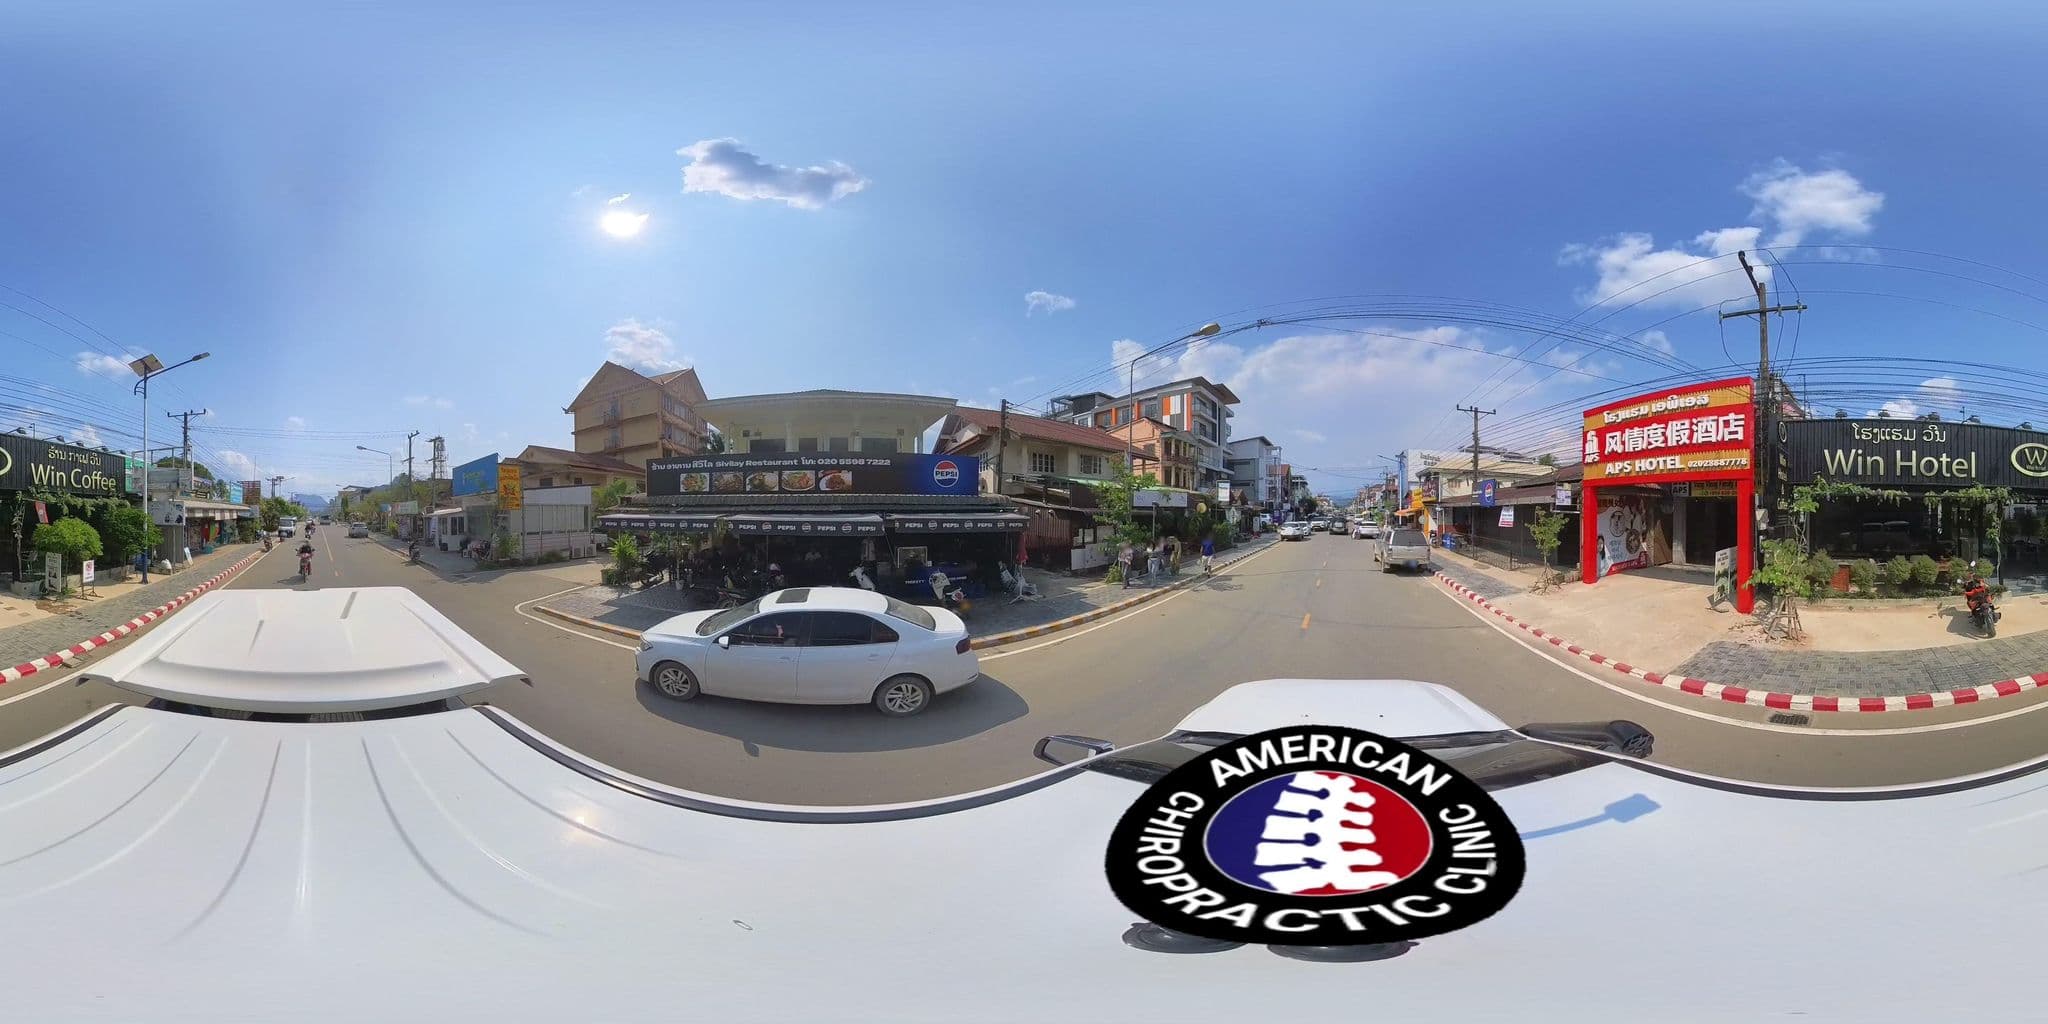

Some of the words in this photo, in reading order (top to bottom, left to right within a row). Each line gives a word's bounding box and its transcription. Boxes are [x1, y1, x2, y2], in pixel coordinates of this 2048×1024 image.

[1605, 413, 1745, 455] 风情度假酒店
[1851, 422, 1916, 444] ໂຮງແຮມ
[1922, 424, 1946, 443] ວິນ
[935, 470, 958, 478] PEPSI
[1605, 460, 1632, 475] APS
[1635, 456, 1685, 472] HOTEL
[1823, 449, 1884, 477] Win
[1896, 450, 1976, 478] Hotel
[31, 463, 66, 487] Win
[71, 469, 117, 491] Coffee
